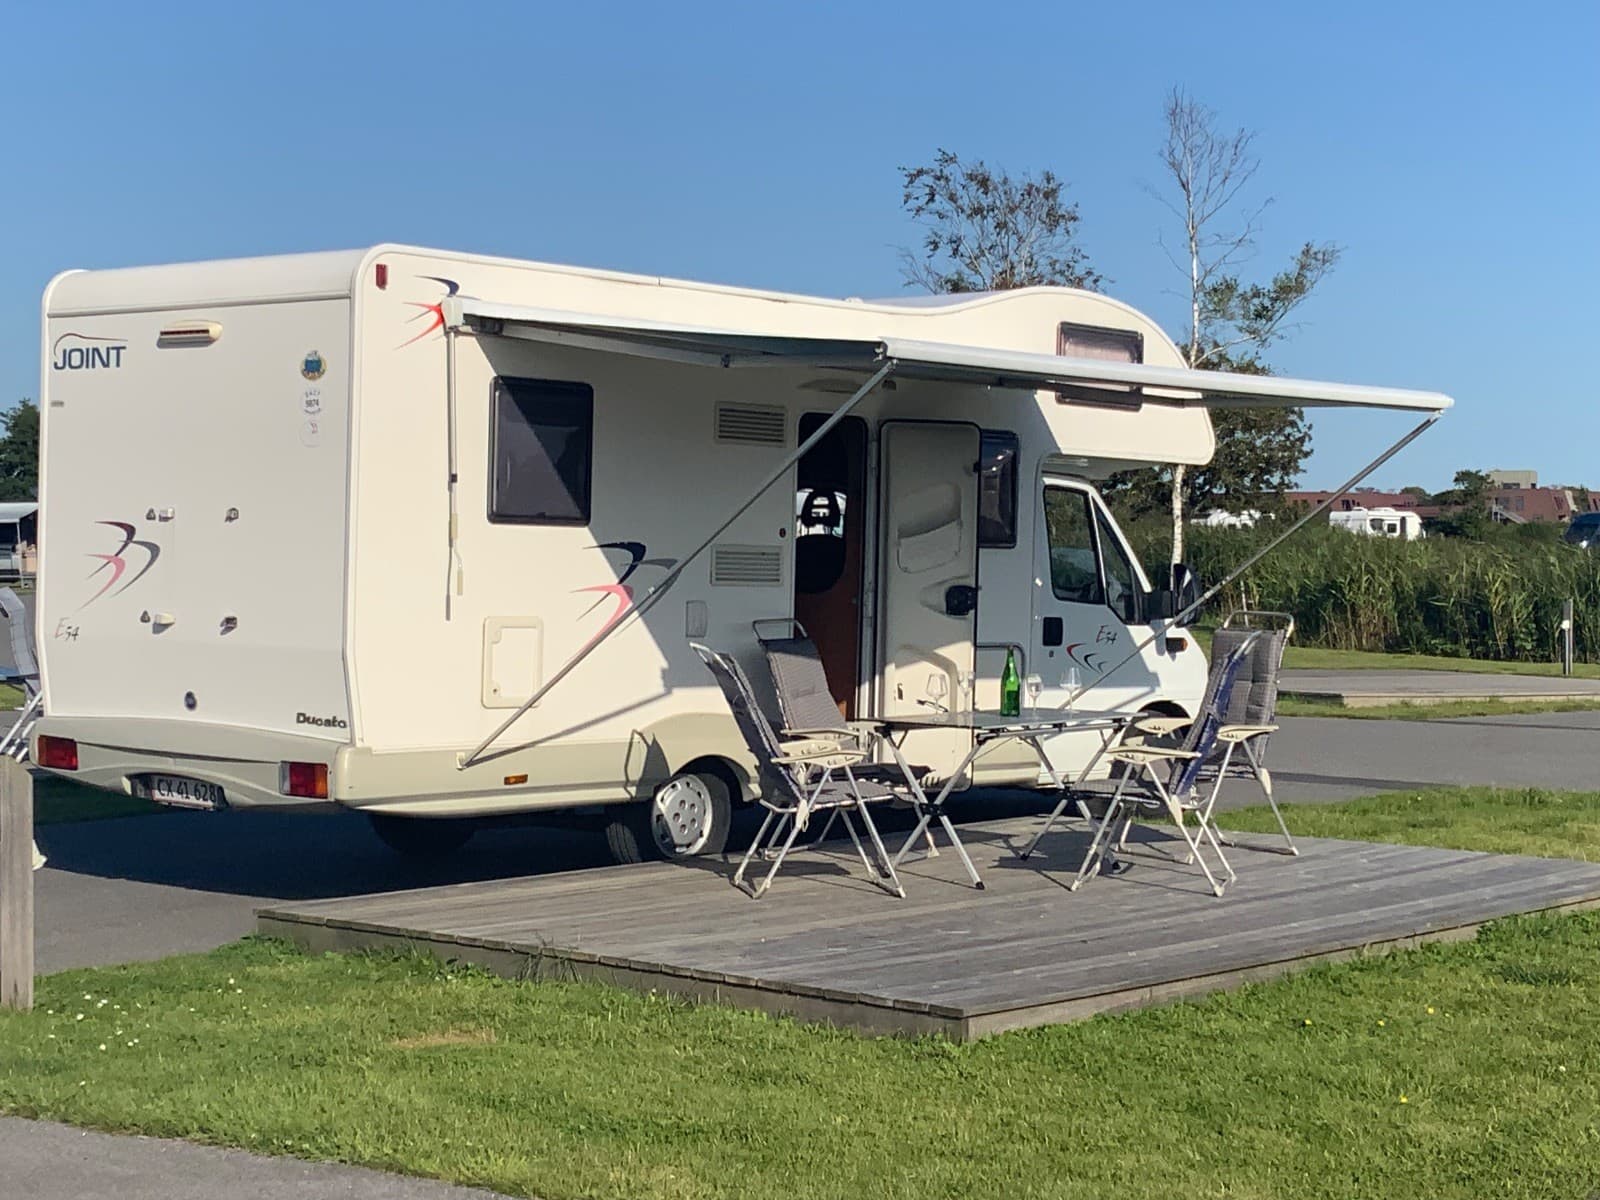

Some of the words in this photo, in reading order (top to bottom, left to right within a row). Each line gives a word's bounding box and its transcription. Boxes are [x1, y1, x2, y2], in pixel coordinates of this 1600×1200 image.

[53, 346, 127, 370] JOINT
[296, 712, 347, 728] Ducato
[157, 779, 174, 797] CX
[176, 781, 190, 799] 41
[194, 783, 217, 803] 628
